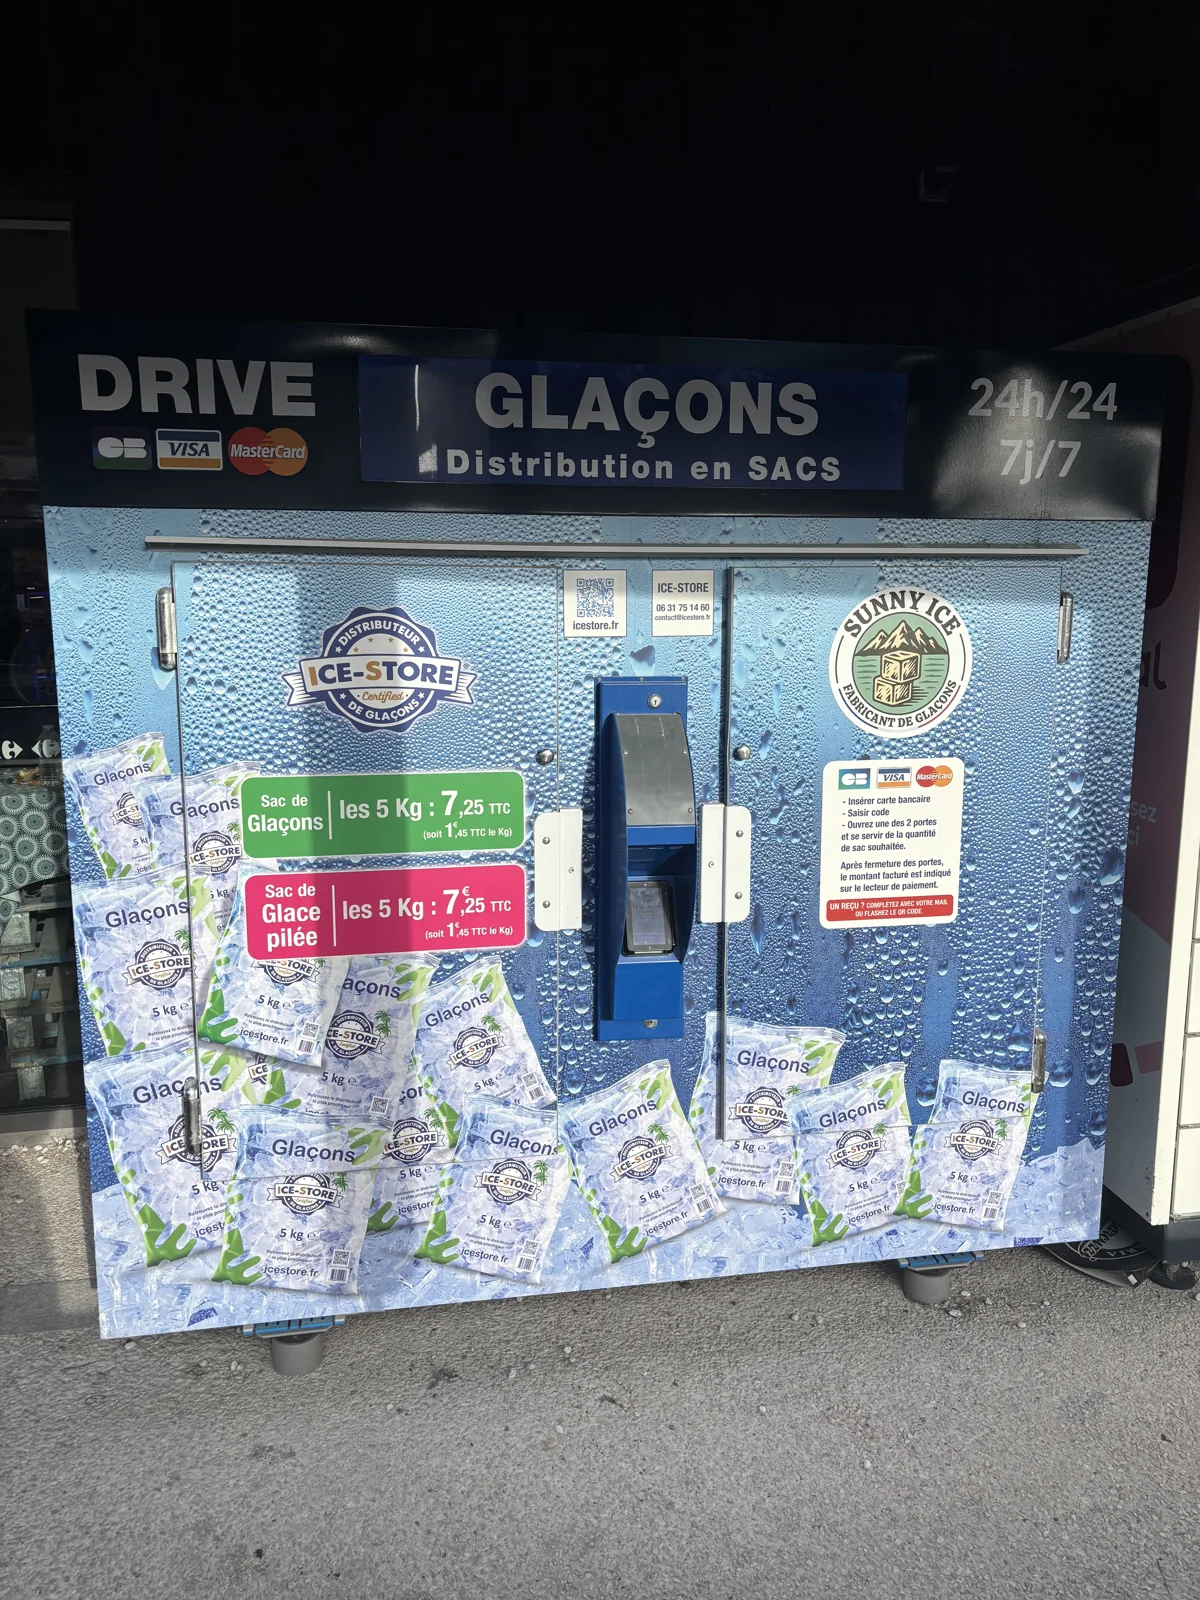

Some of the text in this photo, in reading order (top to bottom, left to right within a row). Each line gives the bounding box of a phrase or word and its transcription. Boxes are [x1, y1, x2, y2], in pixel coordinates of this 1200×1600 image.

[78, 354, 315, 416] DRIVE
[968, 377, 1118, 420] 24h/24
[475, 373, 818, 448] GLAÇONS
[167, 442, 210, 457] VISA
[231, 444, 306, 459] MasterCard
[447, 449, 840, 481] Distribution en SACS
[1000, 440, 1081, 485] 7j/7
[658, 583, 708, 593] ICE-STORE
[844, 590, 961, 638] SUNNY ICE
[338, 621, 420, 646] DISTRIBUTEUR
[573, 621, 618, 630] icestore.fr
[309, 661, 453, 686] ICE-STORE
[362, 691, 404, 703] Certified
[843, 680, 957, 728] FABRICANT DE GLAÇONS
[348, 700, 419, 721] DE GLAÇONS
[94, 762, 150, 786] Glaçons
[170, 798, 240, 818] Gaçons
[261, 794, 308, 807] Sac de
[848, 797, 874, 805] Insérer
[898, 795, 930, 804] bancaire
[340, 799, 370, 819] les
[377, 799, 389, 818] 5
[396, 798, 422, 821] Kg
[489, 803, 510, 814] TTC
[848, 808, 889, 817] Saisir code
[248, 814, 323, 836] Glaçons
[914, 819, 937, 828] portes
[424, 830, 442, 840] (soit
[499, 828, 512, 837] Kg)
[905, 829, 936, 839] quantité
[190, 847, 240, 863] ICE-STORE
[841, 844, 850, 852] de
[868, 842, 906, 851] souhaitée.
[841, 859, 943, 870] Après fermeture des portes,
[850, 872, 880, 880] montant
[883, 871, 908, 879] facturé
[924, 869, 951, 878] indiqué
[265, 884, 316, 898] Sac de
[863, 883, 889, 891] lecteur
[902, 881, 938, 891] paiement.
[106, 901, 189, 928] Glaçons
[262, 904, 321, 923] Glace
[343, 900, 372, 919] les
[379, 899, 391, 917] 5
[398, 898, 424, 920] Kg
[490, 900, 511, 911] TTC
[841, 902, 858, 911] REÇU
[267, 927, 318, 951] pilée
[426, 930, 444, 939] (soit
[500, 926, 513, 935] Kg)
[132, 958, 189, 976] ICE-STORE
[258, 994, 280, 1009] 5 kg
[153, 1004, 177, 1017] 5 kg
[425, 993, 489, 1027] Glaçons
[453, 1037, 498, 1062] ICE-STORE
[738, 1050, 810, 1074] Glaçons
[321, 1072, 345, 1086] 5 kg
[962, 1091, 1025, 1113] Glaçons
[589, 1100, 657, 1137] Glaçons
[819, 1099, 886, 1128] Glaçons
[384, 1133, 437, 1151] ICE-STORE
[734, 1141, 755, 1153] 5 kg
[953, 1135, 996, 1147] ICE-STORE
[272, 1139, 355, 1162] Glaçons
[833, 1140, 880, 1161] ICE-STORE
[617, 1147, 664, 1173] ICE-STORE
[400, 1167, 422, 1179] 5 kg
[950, 1171, 968, 1182] 5 kg
[484, 1175, 534, 1192] ICE-STORE
[849, 1181, 868, 1192] 5 kg
[277, 1187, 335, 1200] ICE-STORE
[640, 1190, 660, 1203] 5 kg
[480, 1215, 501, 1228] 5 kg
[280, 1228, 303, 1241] 5 kg
